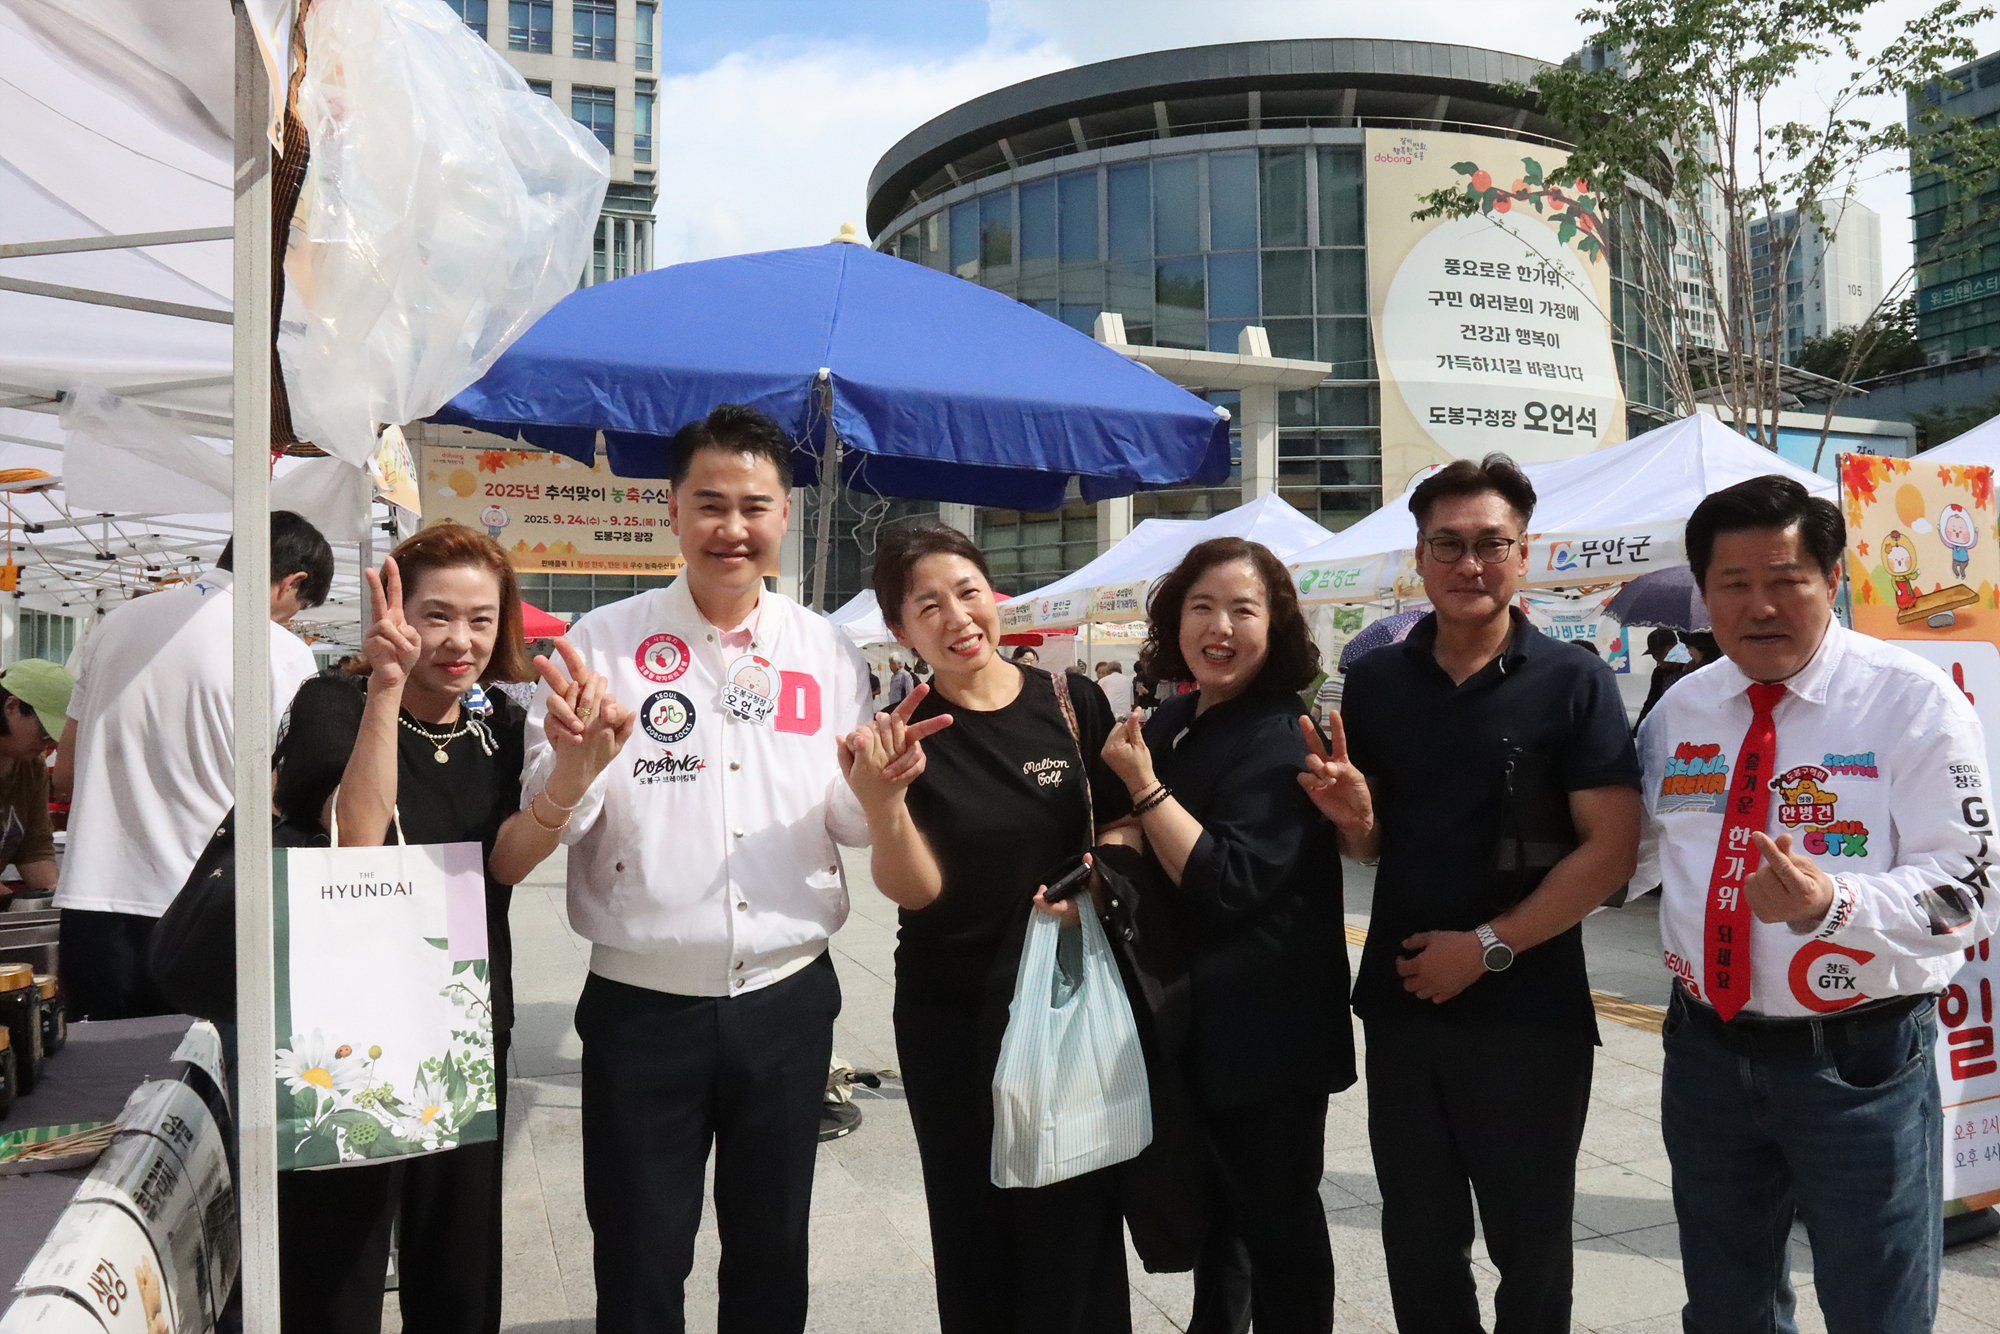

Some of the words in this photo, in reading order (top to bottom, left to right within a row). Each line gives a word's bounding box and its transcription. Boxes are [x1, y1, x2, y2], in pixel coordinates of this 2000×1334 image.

[1374, 153, 1412, 165] dobong
[1444, 257, 1512, 281] 풍요로운
[1516, 263, 1565, 290] 한가위,
[1847, 284, 1863, 297] 105
[1428, 290, 1463, 308] 구민
[1469, 291, 1534, 315] 여러분의
[1539, 299, 1580, 322] 가정에
[1460, 324, 1511, 344] 건강과
[1515, 327, 1561, 349] 행복이
[1436, 354, 1522, 376] 가득하시길
[1526, 360, 1584, 382] 바랍니다
[1429, 406, 1517, 429] 도봉구청장
[1523, 400, 1597, 438] 오언석
[484, 483, 540, 500] 2025년
[545, 485, 606, 501] 추석맞이
[524, 515, 552, 524] 2025.
[553, 514, 565, 524] 9.
[610, 515, 621, 526] 9.
[659, 518, 670, 528] 10
[594, 531, 632, 543] 도봉구청
[634, 532, 654, 543] 광장
[1579, 534, 1652, 568] 무안군
[630, 562, 643, 570] 우수
[1318, 568, 1361, 589] 함평군
[654, 691, 677, 700] SEOUL
[733, 686, 767, 707] 도봉구청장
[774, 670, 822, 736] D
[725, 695, 766, 721] 오언석
[645, 725, 673, 742] DOBONG
[674, 722, 693, 741] SOCKS
[633, 754, 700, 778] DOBONG
[1023, 757, 1070, 774] Malbon
[1786, 767, 1826, 780] 도봉구의회
[1949, 764, 1981, 775] SEOUL
[640, 777, 661, 785] 도봉구
[1037, 770, 1063, 788] Golf
[1737, 752, 1760, 815] 즐거운
[1953, 775, 1982, 789] 창동
[1798, 796, 1812, 804] 의장
[1781, 805, 1832, 821] 안병건
[1805, 820, 1869, 836] OUL
[1803, 831, 1868, 857] GTX
[359, 872, 375, 880] THE
[1717, 825, 1751, 912] 한가위
[321, 881, 414, 900] HYUNDAI
[1815, 898, 1848, 939] AREN
[1664, 950, 1694, 980] SEOUL
[1716, 924, 1733, 990] 되세요
[1826, 963, 1850, 975] 창동
[1818, 975, 1857, 990] GTX
[1953, 1121, 1977, 1141] 오후
[1982, 1115, 2000, 1134] 2시
[1955, 1148, 1978, 1168] 오후
[1984, 1142, 2000, 1161] 4시
[87, 1257, 127, 1316] 생강
